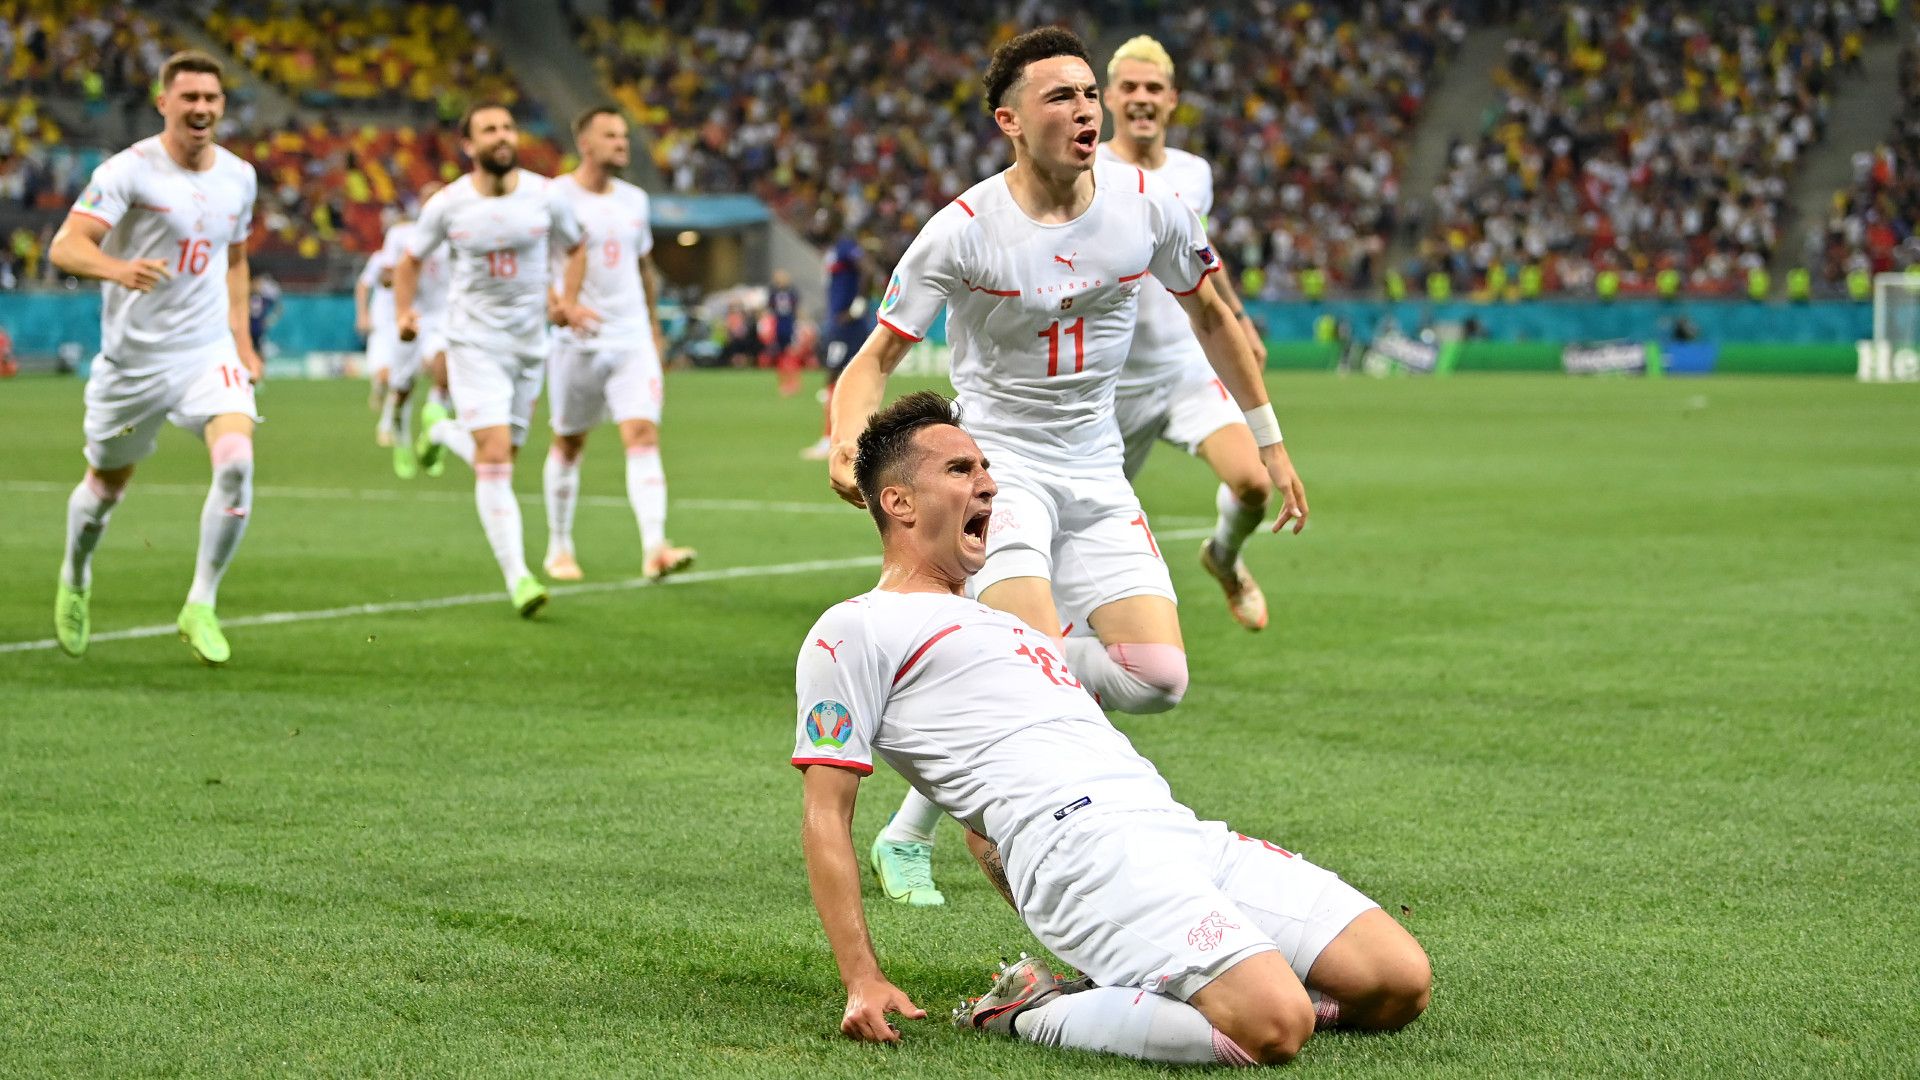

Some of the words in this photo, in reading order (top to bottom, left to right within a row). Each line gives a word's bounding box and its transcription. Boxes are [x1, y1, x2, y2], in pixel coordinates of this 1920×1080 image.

[177, 237, 213, 276] 16
[486, 249, 518, 280] 18
[603, 239, 622, 269] 9
[1037, 316, 1084, 378] 11
